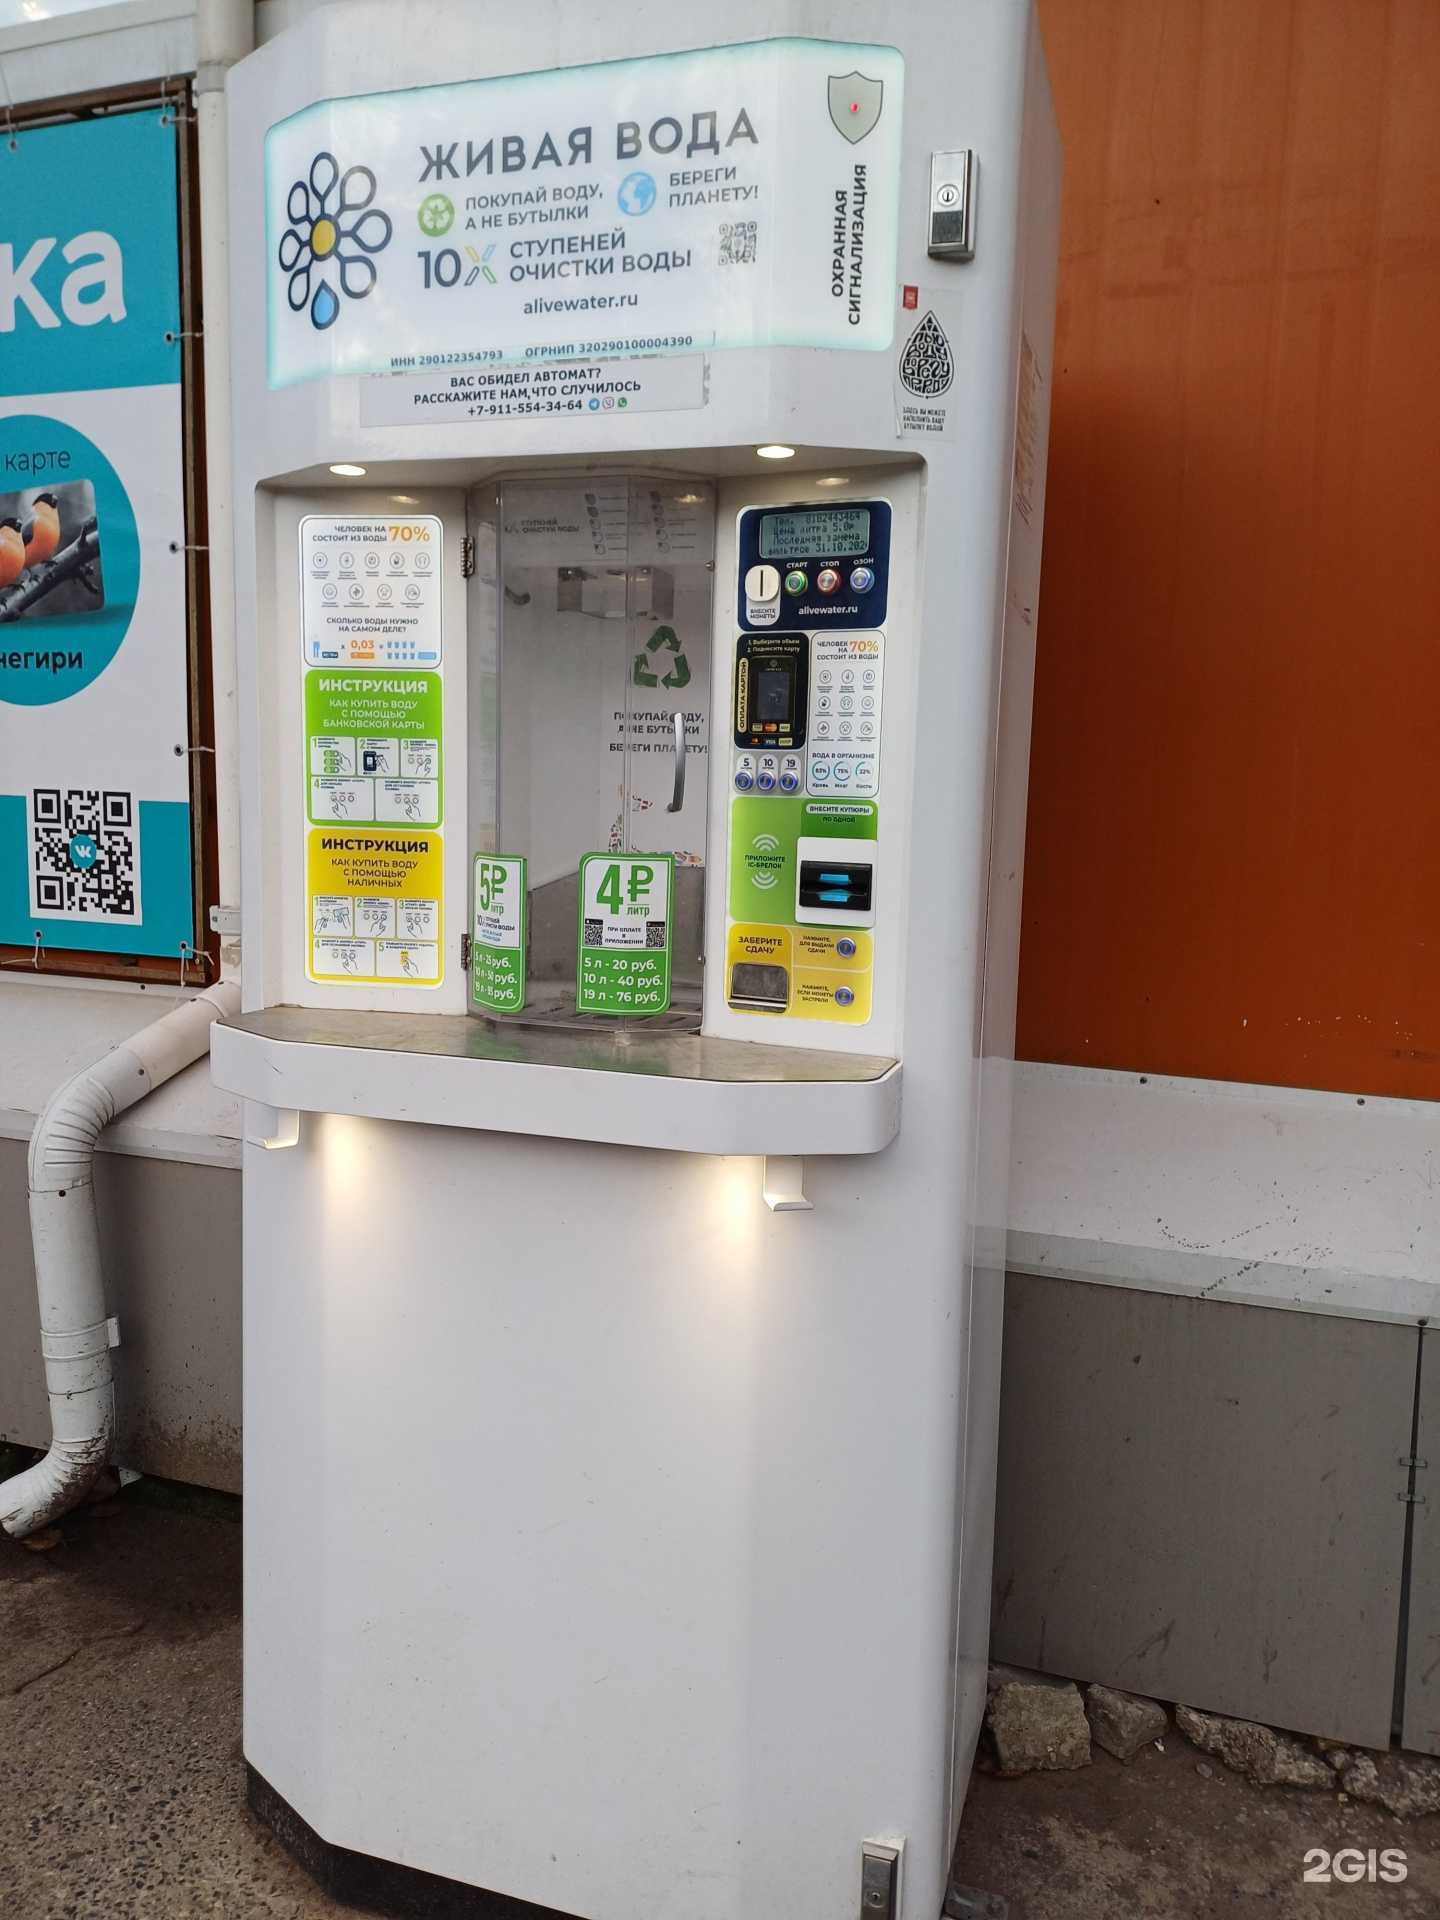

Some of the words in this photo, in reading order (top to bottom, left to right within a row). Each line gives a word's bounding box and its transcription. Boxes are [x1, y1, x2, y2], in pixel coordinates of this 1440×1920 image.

[418, 126, 592, 182] ЖИВАЯ
[617, 107, 759, 161] ВОДА
[669, 166, 736, 187] БЕРЕГИ
[465, 186, 547, 210] ПОКУПАЙ
[552, 184, 603, 202] ВОДУ,
[669, 185, 759, 208] ПЛАНЕТУ!
[465, 217, 477, 230] А
[481, 214, 503, 228] НЕ
[508, 206, 589, 227] БУТЫЛКИ
[510, 229, 626, 259] СТУПЕНЕЙ
[832, 190, 847, 297] ОХРАННАЯ
[849, 164, 867, 325] СИГНАЛИЗАЦИЯ
[510, 257, 613, 282] ОЧИСТКИ
[622, 250, 691, 273] ВОДЫ
[523, 294, 638, 314] alivewater.ru
[391, 357, 415, 368] ИНН
[419, 350, 503, 366] 290122354793
[525, 345, 575, 358] ОГРНИП
[579, 336, 692, 354] 320290100004390
[450, 376, 475, 388] ВАС
[479, 371, 530, 387] ОБИДЕЛ
[534, 368, 601, 383] АВТОМАТ?
[414, 389, 497, 405] РАССКАЖИТЕ
[562, 381, 641, 396] СЛУЧИЛОСЬ
[467, 400, 582, 417] +7-911-554-34-64
[5, 449, 71, 476] карте
[334, 525, 372, 533] ЧЕЛОВЕК
[389, 526, 430, 542] 70%
[363, 535, 387, 543] ВОДЫ
[786, 561, 808, 569] СТАРТ
[798, 605, 858, 615] alivewater.ru
[351, 640, 375, 650] 0,03
[849, 640, 879, 652] 70%
[319, 679, 428, 695] ИНСТРУКЦИЯ
[351, 700, 388, 708] КУПИТЬ
[391, 701, 417, 709] ВОДУ
[350, 711, 406, 719] ПОМОЩЬЮ
[323, 718, 390, 728] БАНКОВСКОЙ
[392, 721, 424, 730] КАРТЫ
[360, 740, 366, 749] 2
[403, 740, 409, 749] 3
[610, 743, 650, 752] БЕЕГИ
[654, 744, 708, 754] ПЛАЕТУ!
[743, 758, 750, 766] 5
[764, 759, 773, 767] 10
[321, 838, 428, 854] ИНСТРУКЦИЯ
[352, 859, 389, 867] КУПИТЬ
[392, 861, 418, 869] ВОДУ
[745, 855, 785, 863] ПРИЛОЖИТЕ
[352, 870, 406, 878] ПОМОЩЬЮ
[347, 879, 402, 887] НАЛИЧНЫХ
[357, 898, 363, 907] 2
[399, 900, 405, 909] 3
[627, 906, 650, 917] литр
[379, 942, 385, 952] 5
[738, 936, 782, 946] ЗАБЕРИТЕ
[746, 946, 774, 954] СДАЧУ
[492, 957, 511, 968] руб.
[584, 957, 591, 967] 5
[594, 960, 601, 969] л
[613, 959, 627, 970] 20
[632, 959, 657, 973] руб.
[495, 973, 517, 985] руб.
[584, 972, 595, 983] 10
[599, 976, 606, 985] л
[618, 975, 633, 986] 40
[638, 975, 663, 989] руб.
[494, 988, 516, 1001] руб.
[584, 988, 595, 999] 19
[599, 992, 606, 1000] л
[617, 991, 631, 1002] 76
[635, 991, 661, 1006] руб.
